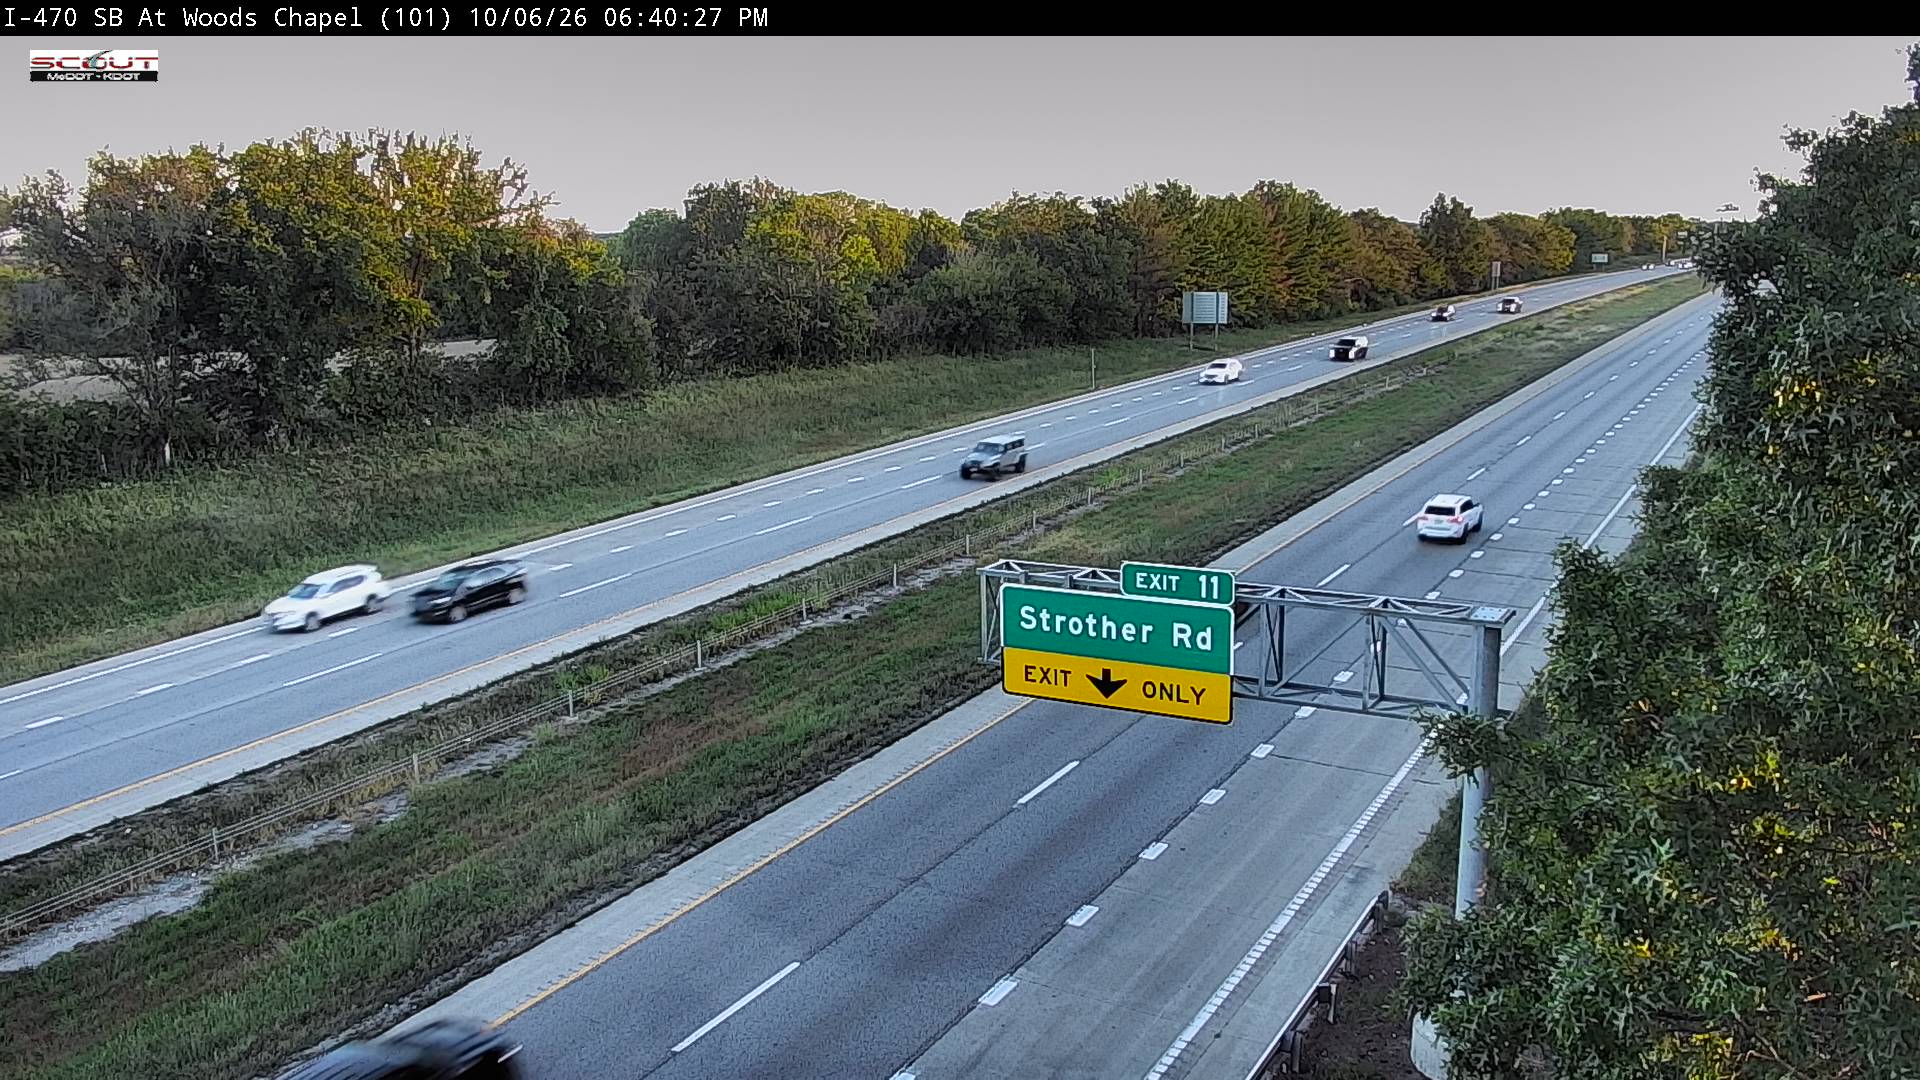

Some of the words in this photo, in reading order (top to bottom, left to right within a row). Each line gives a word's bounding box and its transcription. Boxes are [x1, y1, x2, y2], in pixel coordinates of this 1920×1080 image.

[1135, 572, 1181, 591] EXIT
[1199, 574, 1219, 599] 11
[1019, 605, 1154, 643] Strother
[1172, 622, 1213, 651] Rd
[1024, 664, 1072, 688] EXIT
[1142, 680, 1208, 706] ONLY
